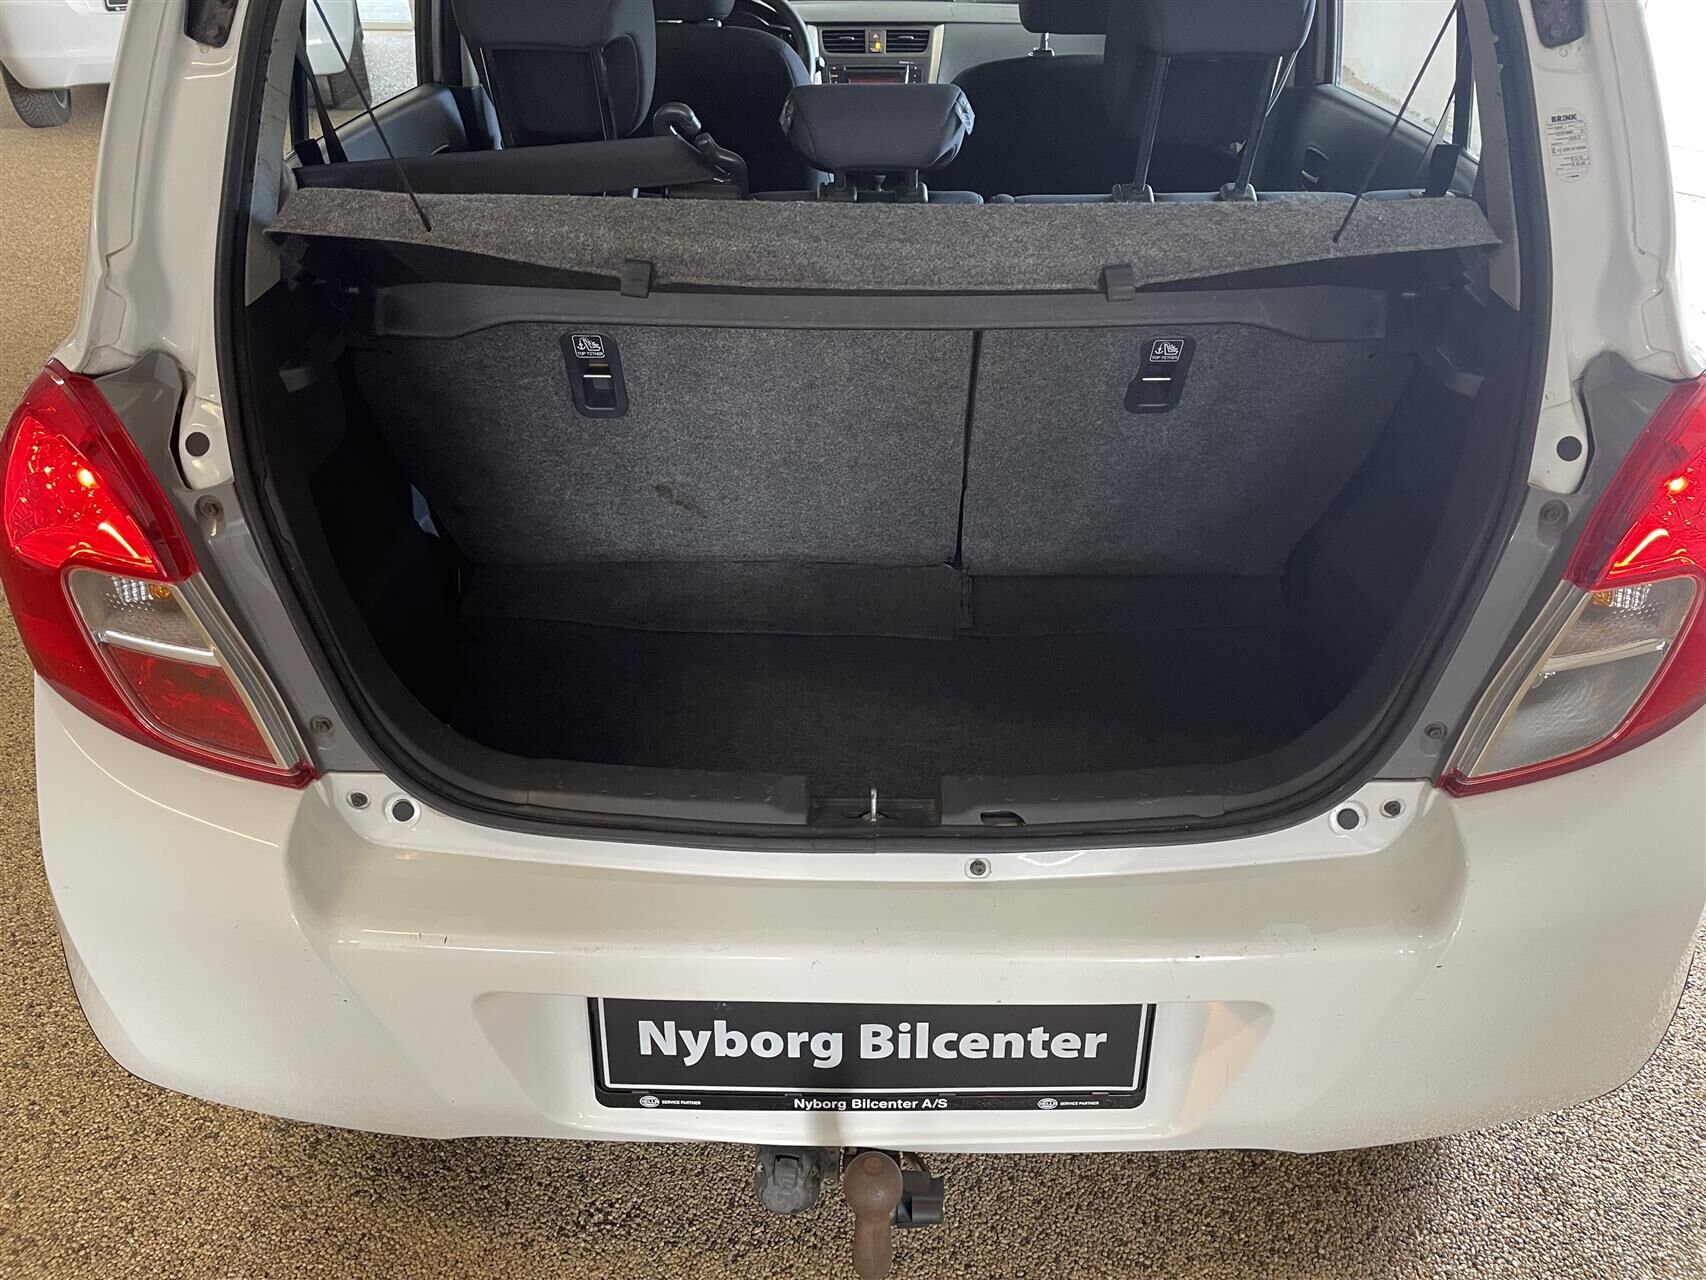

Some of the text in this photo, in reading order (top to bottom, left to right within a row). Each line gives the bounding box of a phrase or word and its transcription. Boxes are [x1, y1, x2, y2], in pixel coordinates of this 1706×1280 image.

[638, 1020, 1107, 1068] Nyborg Bilcenter
[793, 1098, 948, 1110] Nyborg Bilcenter A/S
